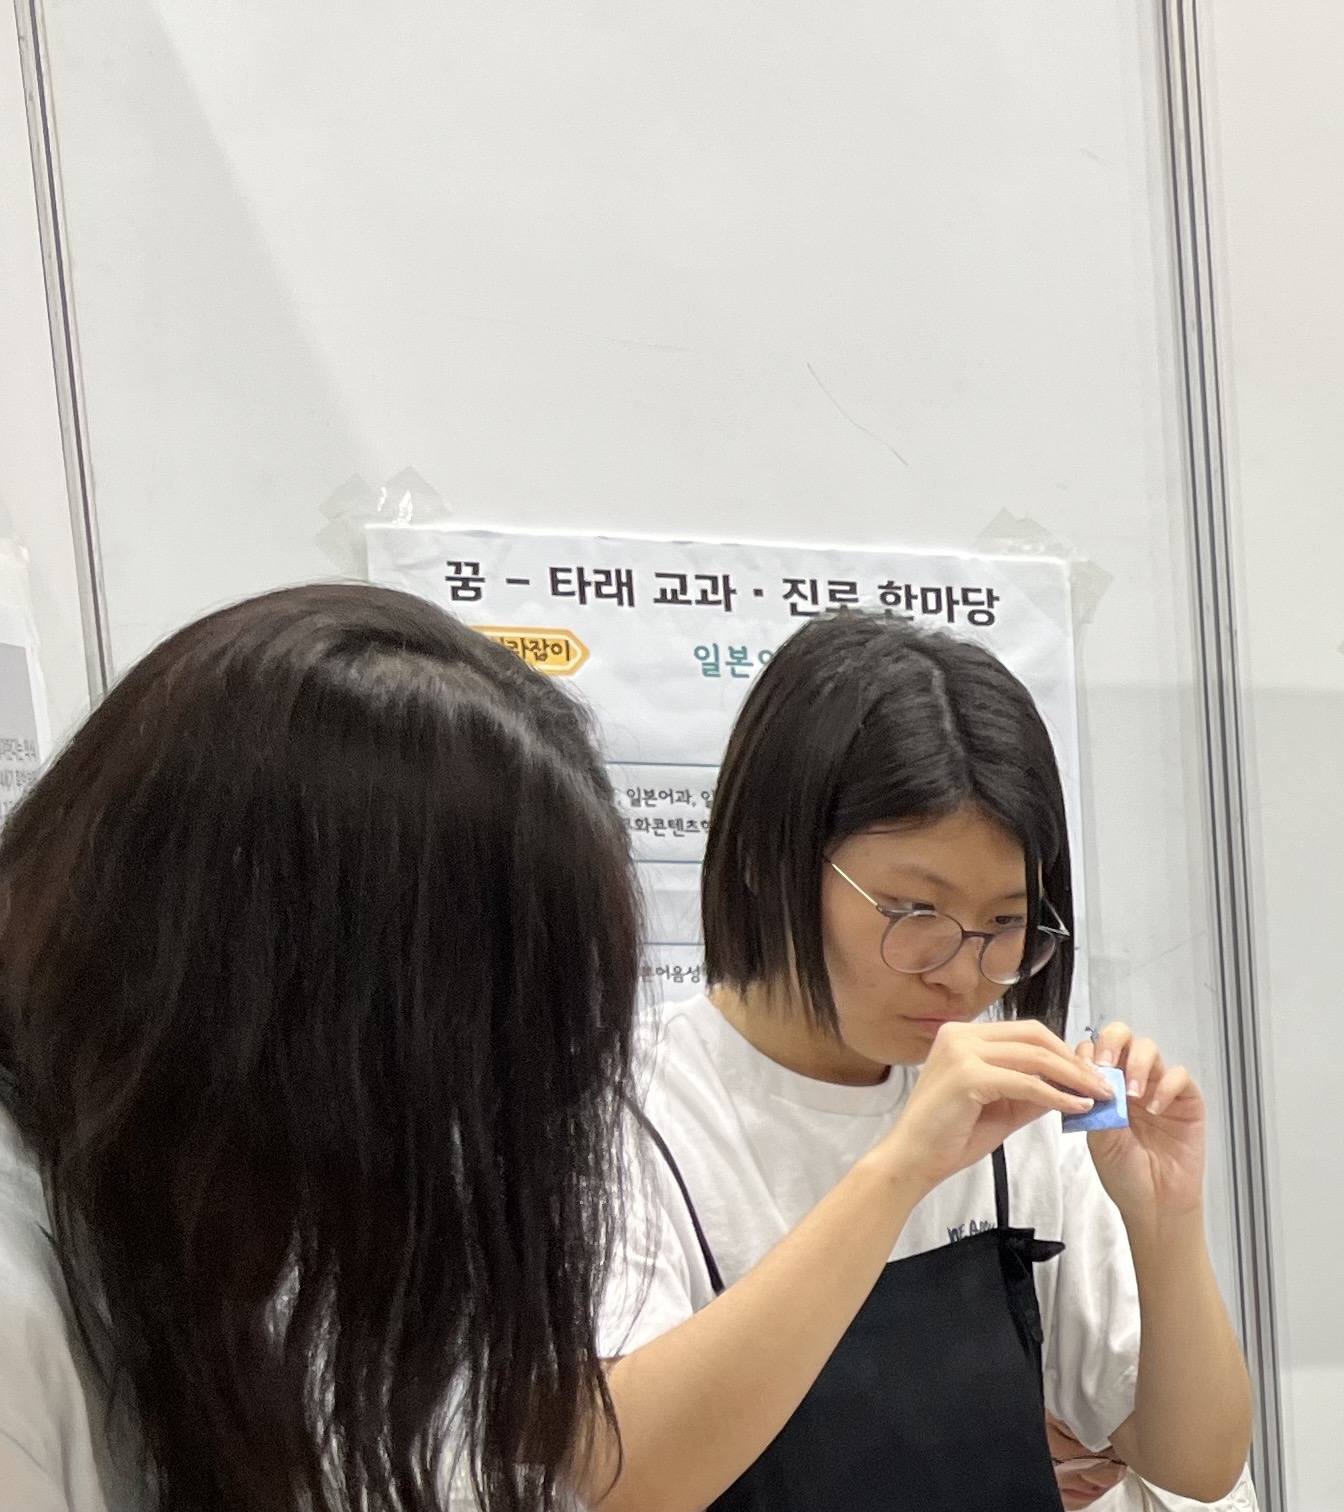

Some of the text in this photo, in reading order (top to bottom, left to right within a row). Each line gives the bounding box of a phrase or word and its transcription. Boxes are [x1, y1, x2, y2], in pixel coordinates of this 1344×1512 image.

[444, 560, 1000, 630] 꿈 타래 교과 진로 한마당
[498, 637, 570, 662] 라잡이
